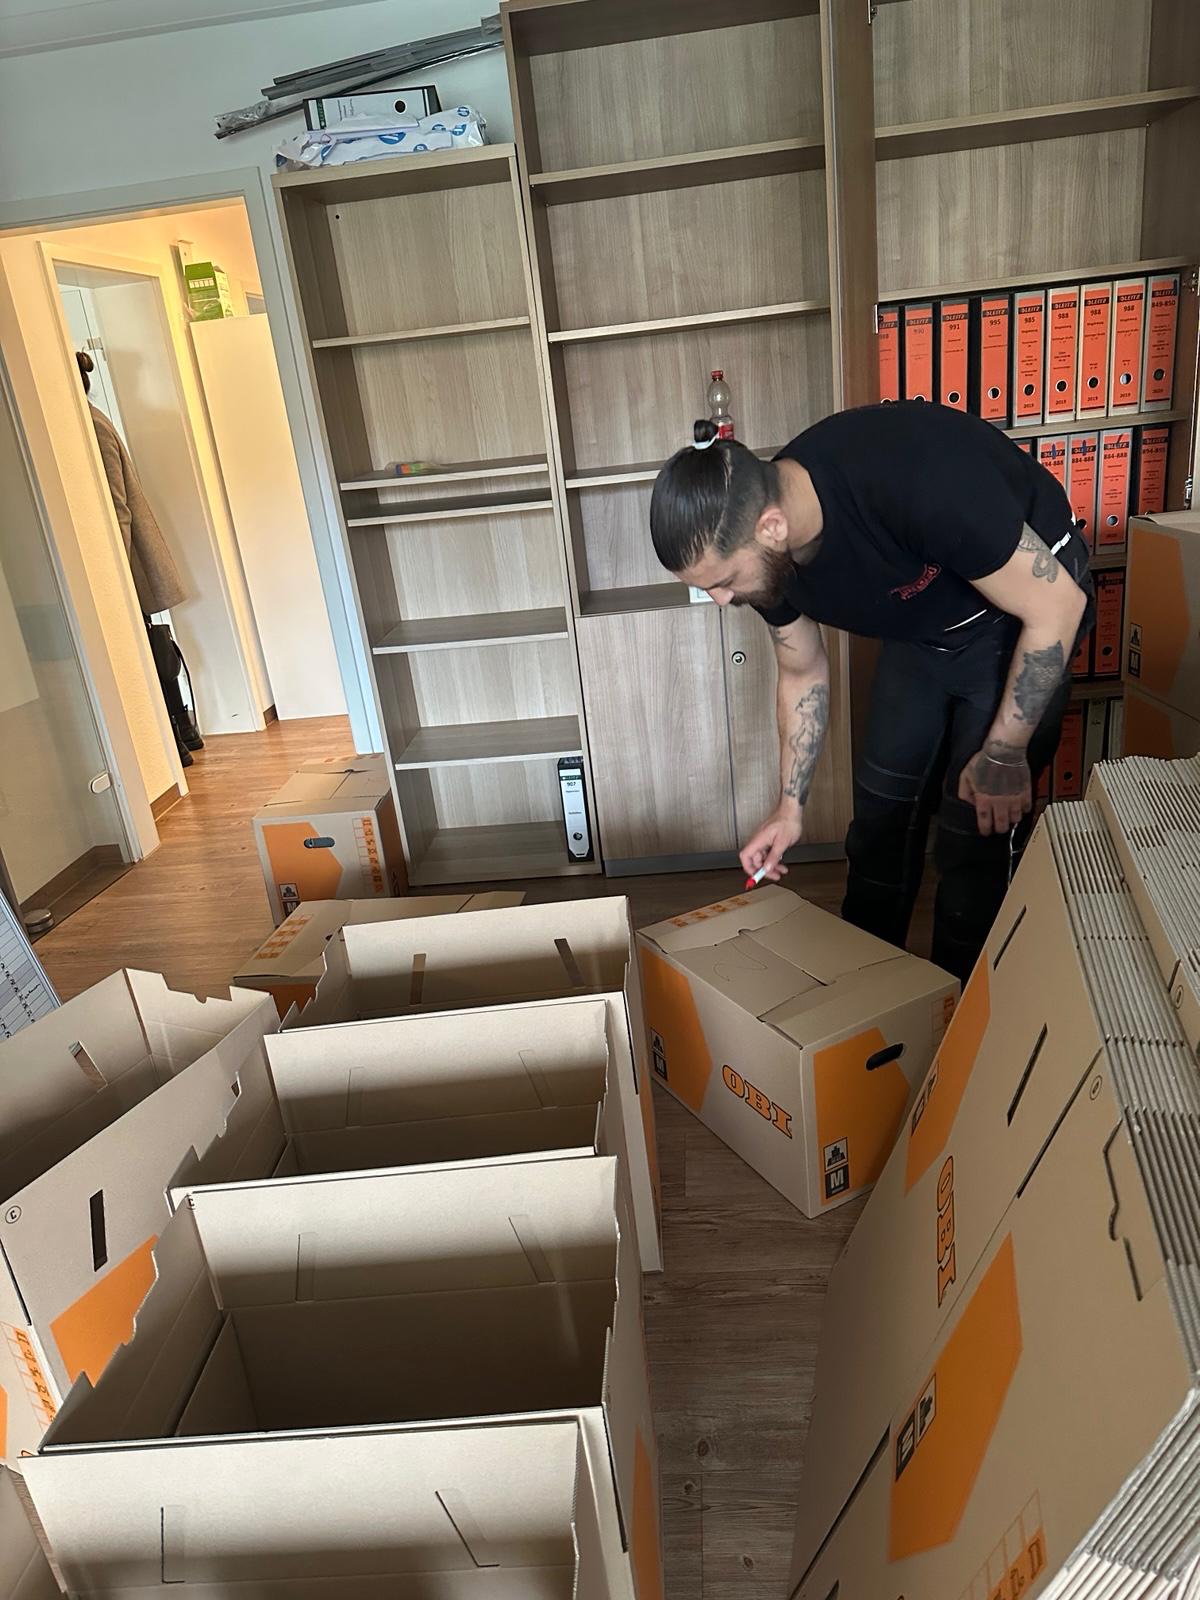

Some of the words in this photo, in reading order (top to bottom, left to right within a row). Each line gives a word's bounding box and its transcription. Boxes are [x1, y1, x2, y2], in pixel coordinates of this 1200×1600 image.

[721, 1063, 793, 1139] OBI
[830, 1168, 844, 1189] M
[936, 1155, 956, 1308] OBI
